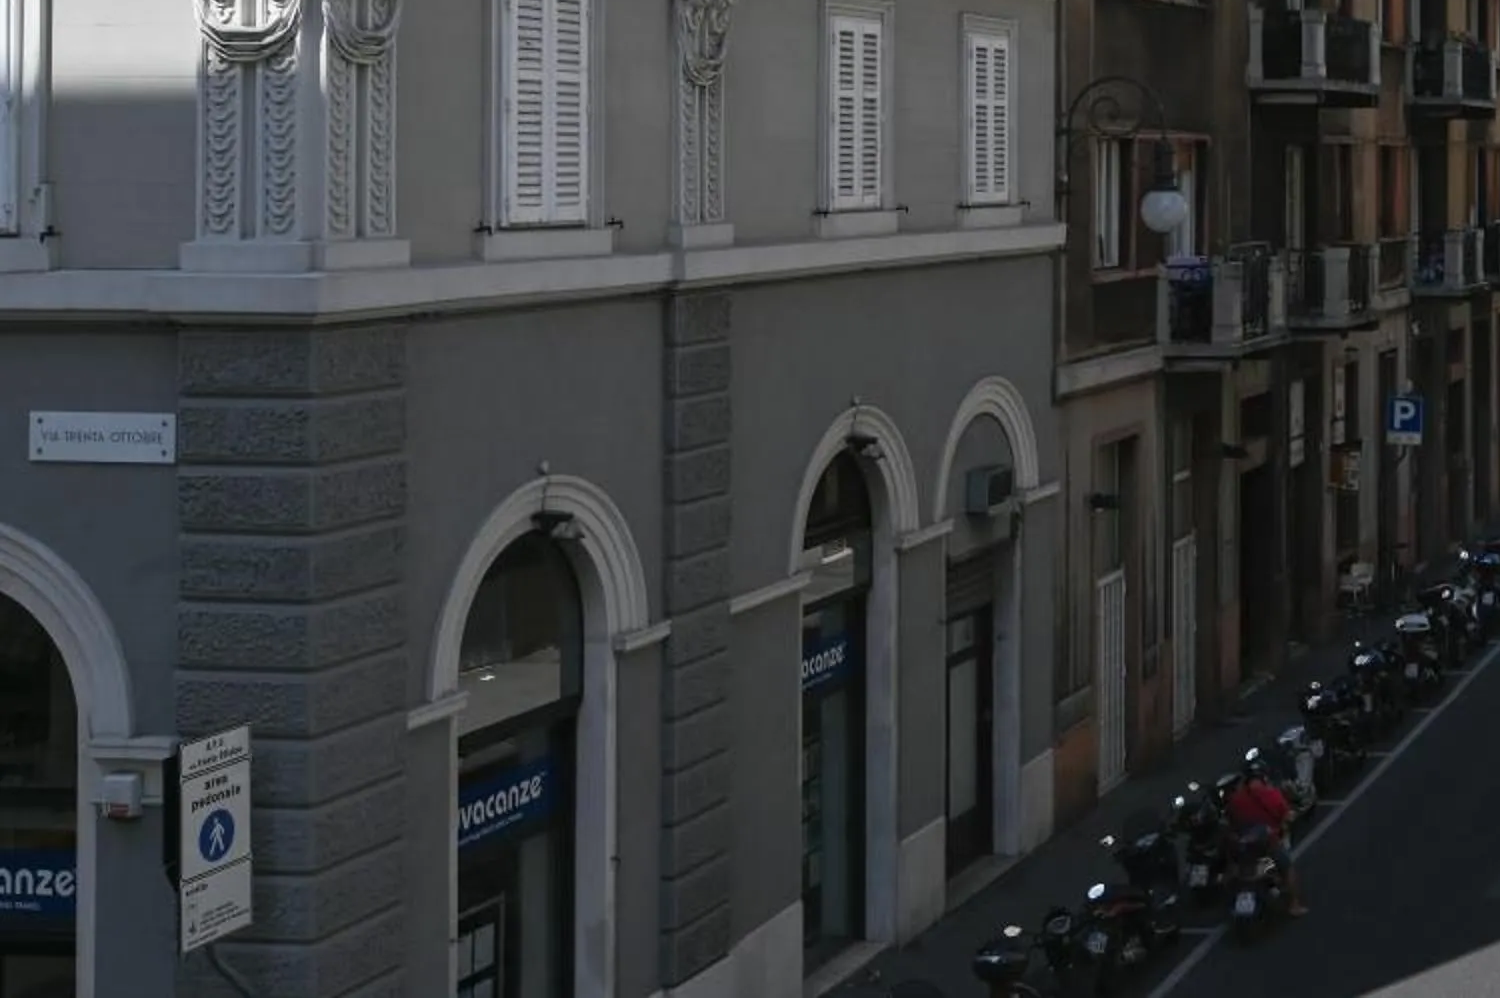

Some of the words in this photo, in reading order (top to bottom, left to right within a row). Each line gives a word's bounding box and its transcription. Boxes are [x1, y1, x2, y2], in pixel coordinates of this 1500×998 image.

[1393, 399, 1417, 430] P
[41, 429, 60, 442] VIA
[64, 429, 106, 443] TRENTA
